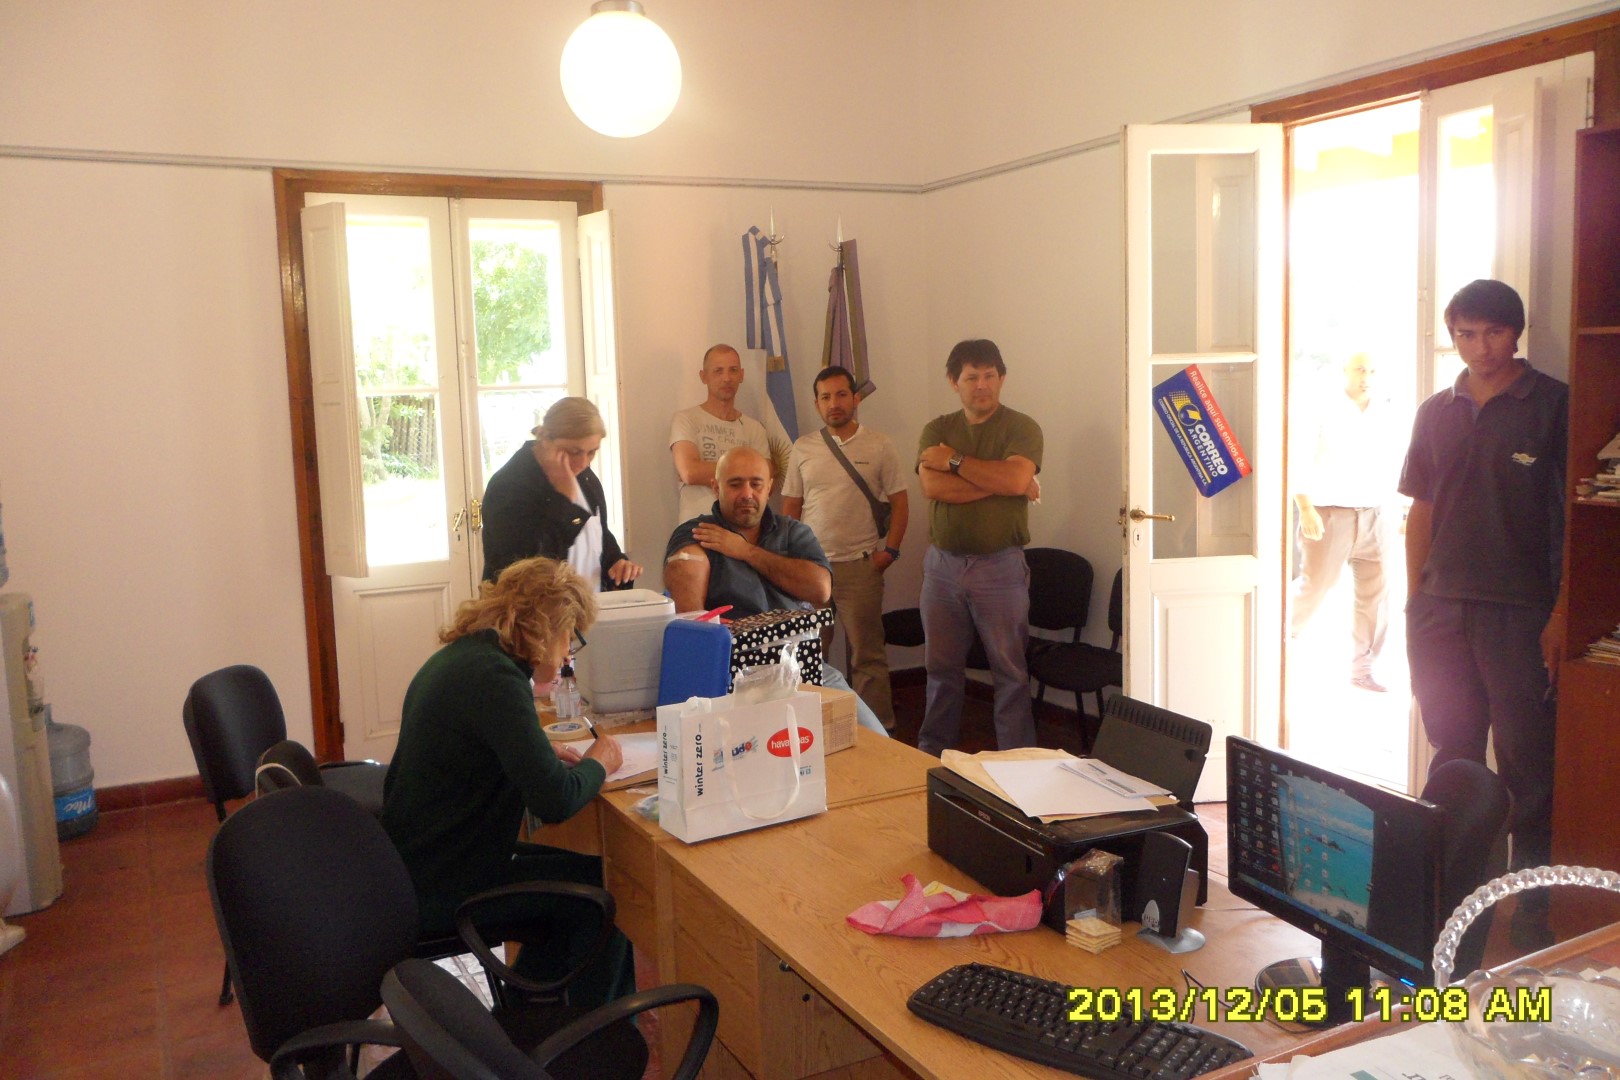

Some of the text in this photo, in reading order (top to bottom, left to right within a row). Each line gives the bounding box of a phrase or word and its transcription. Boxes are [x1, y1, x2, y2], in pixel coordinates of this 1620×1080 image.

[1190, 371, 1207, 398] Realice
[1204, 399, 1218, 417] aquí
[1215, 417, 1224, 431] sus
[1236, 456, 1246, 470] de:
[1188, 428, 1218, 477] ARGENTINO
[1195, 424, 1228, 475] CORREO
[694, 734, 704, 797] winter zero
[771, 735, 809, 749] havaas
